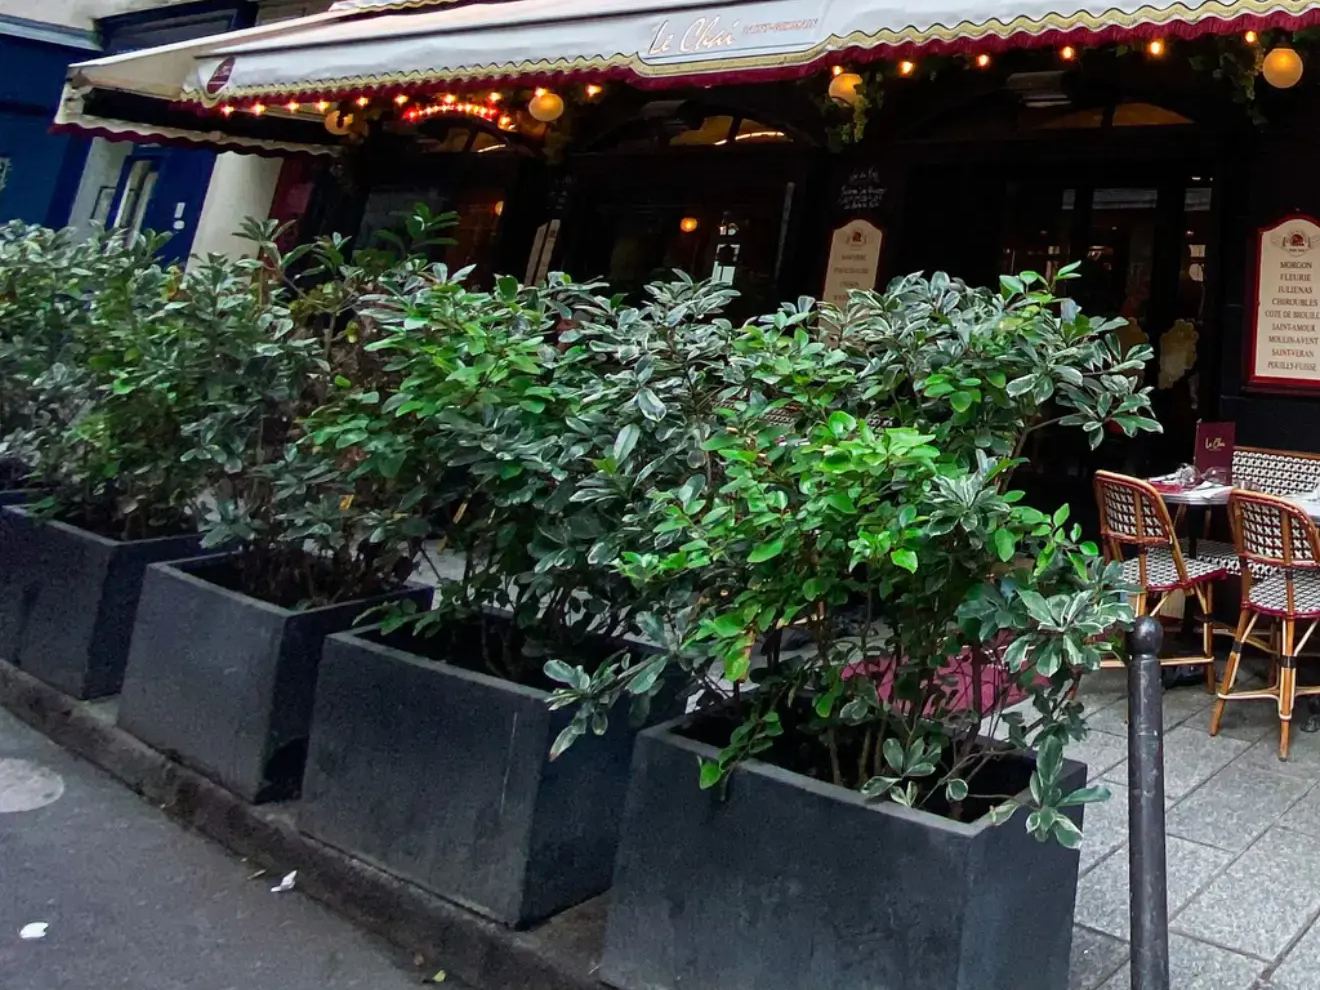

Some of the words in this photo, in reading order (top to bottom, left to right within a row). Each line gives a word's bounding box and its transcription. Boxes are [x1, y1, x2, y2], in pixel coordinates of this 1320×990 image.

[648, 19, 675, 55] Le
[680, 14, 740, 52] Chai
[1280, 273, 1311, 282] FLEURIE
